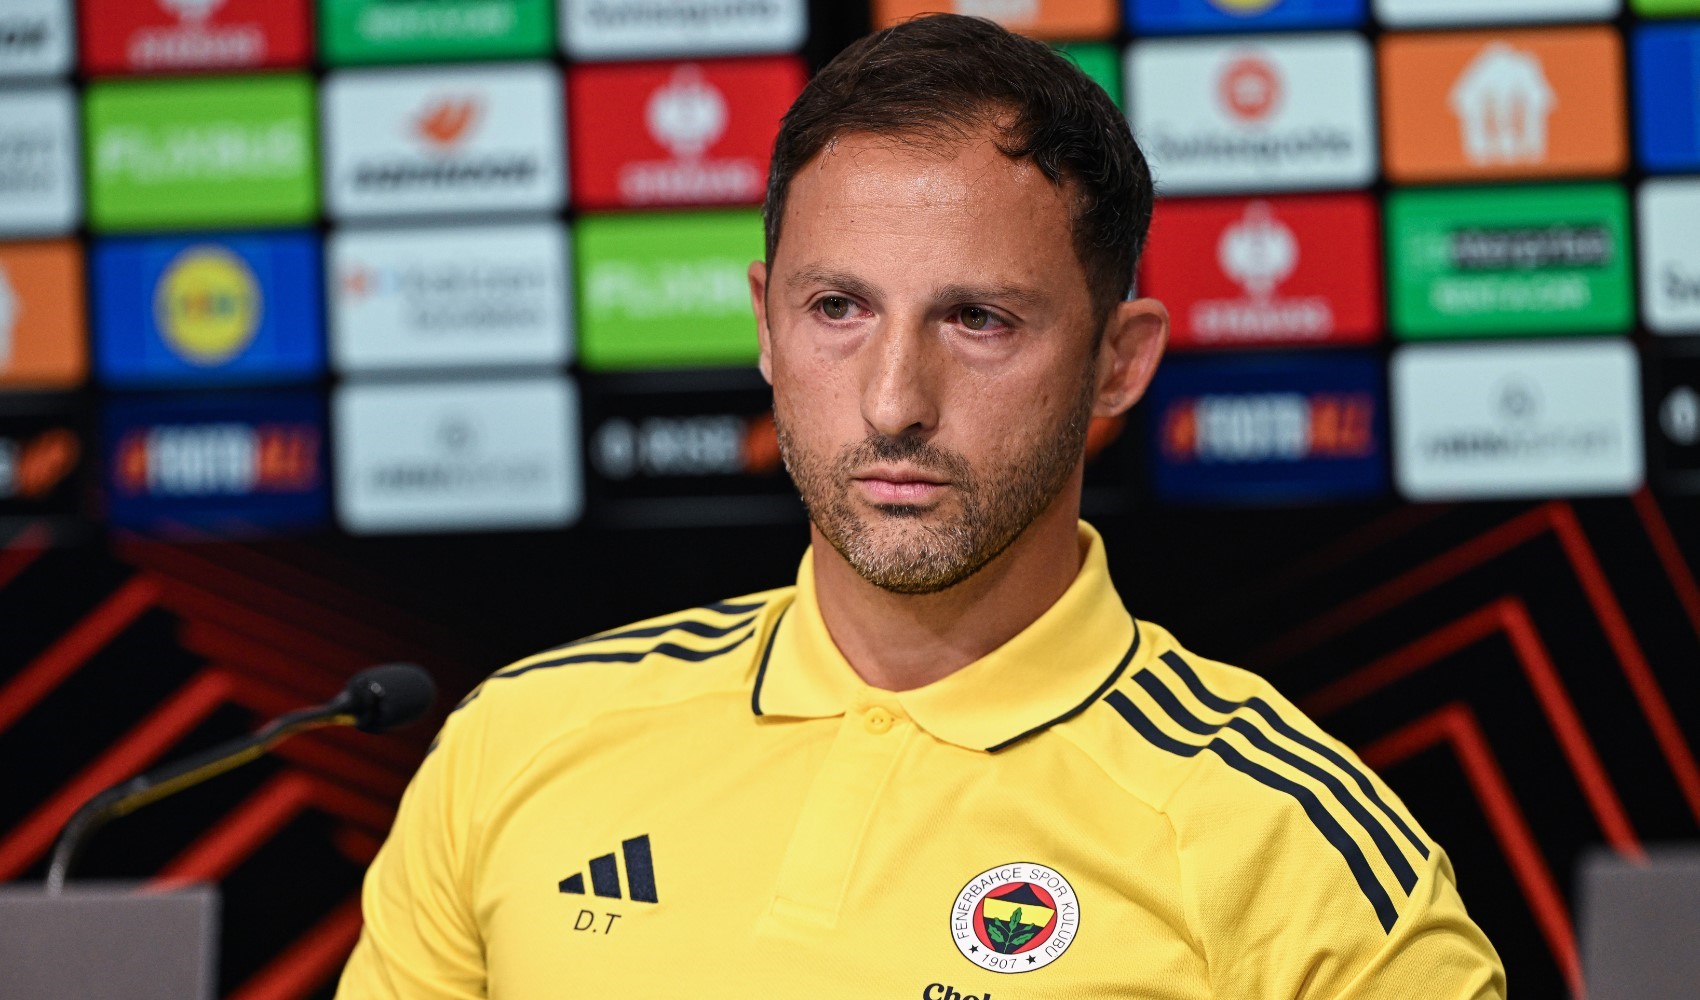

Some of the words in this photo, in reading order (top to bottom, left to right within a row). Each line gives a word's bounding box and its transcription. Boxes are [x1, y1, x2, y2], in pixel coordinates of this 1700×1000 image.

[1029, 868, 1068, 898] SPOR
[955, 866, 1022, 940] FENERBAHÇE
[573, 909, 622, 935] D.T
[1044, 901, 1075, 959] KULÜBÜ
[981, 953, 1018, 969] 1907
[922, 982, 991, 1000] Ch
